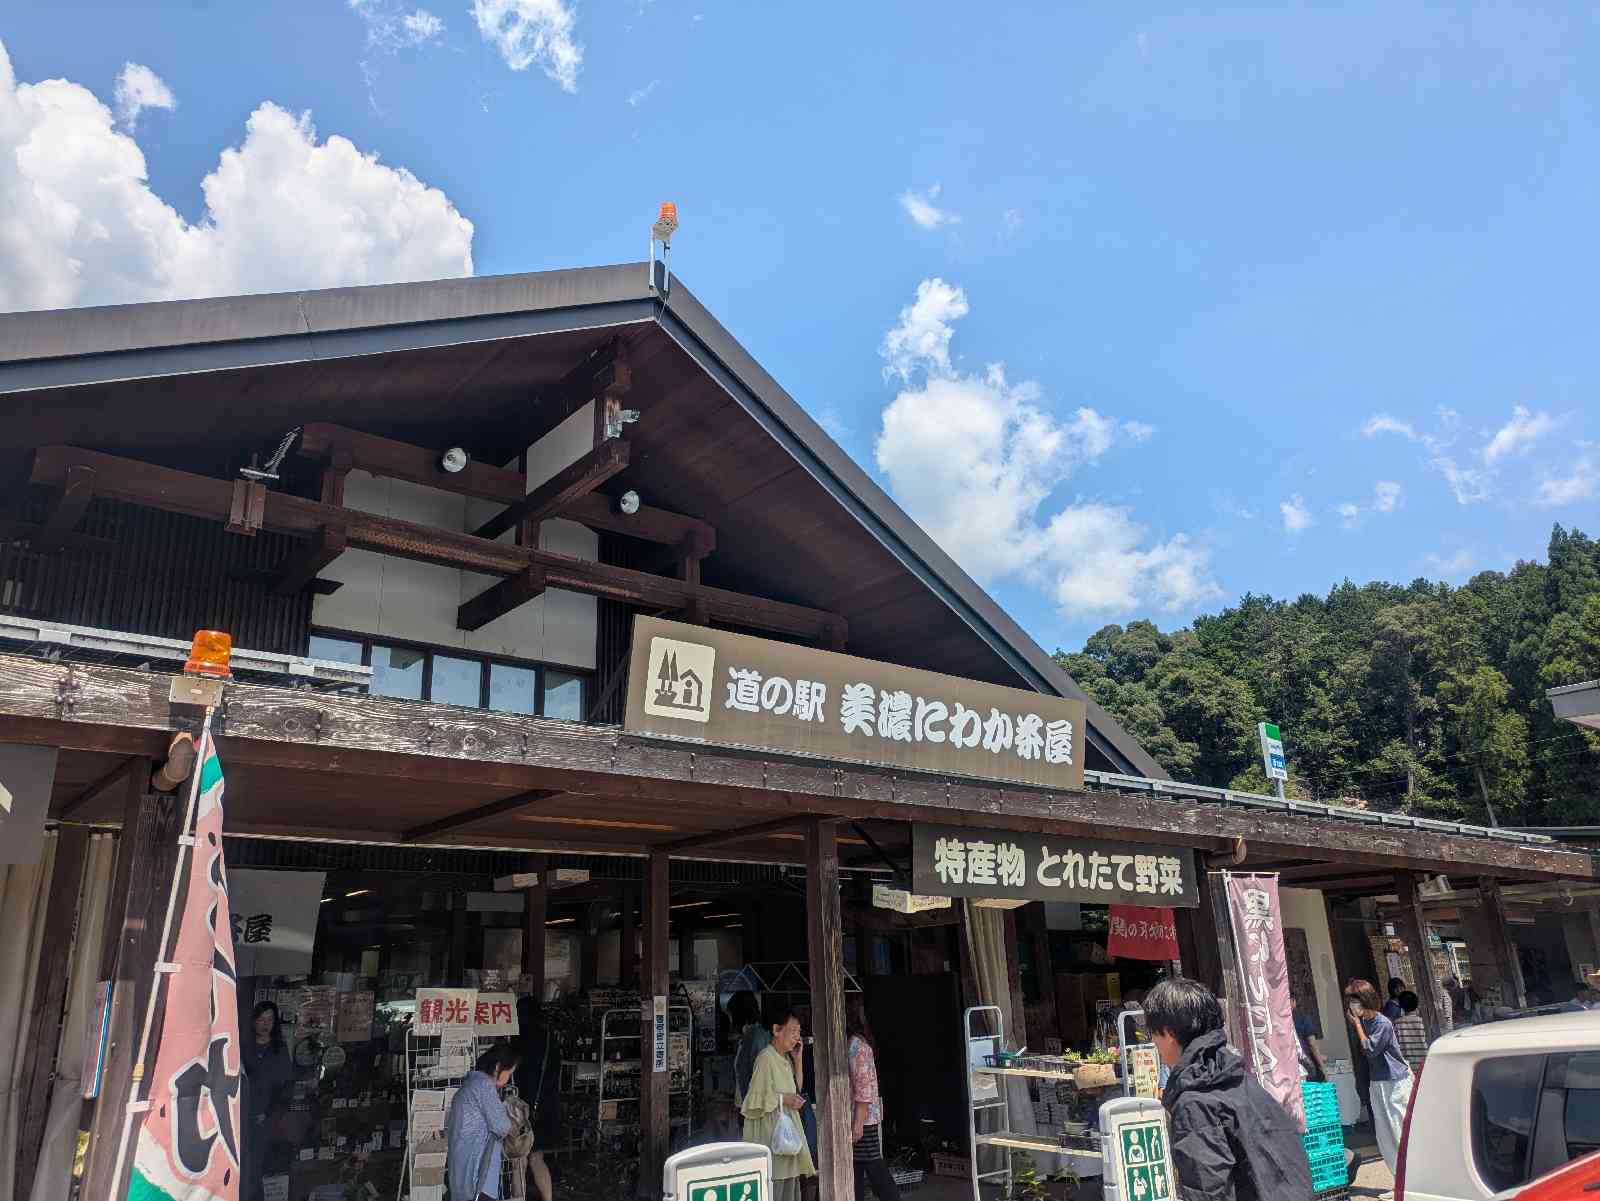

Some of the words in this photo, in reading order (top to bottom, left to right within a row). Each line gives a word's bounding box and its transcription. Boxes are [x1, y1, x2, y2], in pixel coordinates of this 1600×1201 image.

[725, 666, 827, 723] 道の駅
[839, 683, 1073, 765] 美濃にわか茶屋
[934, 837, 1026, 887] 特産物
[1036, 846, 1184, 896] とれたて野菜
[421, 998, 512, 1025] 観光案内
